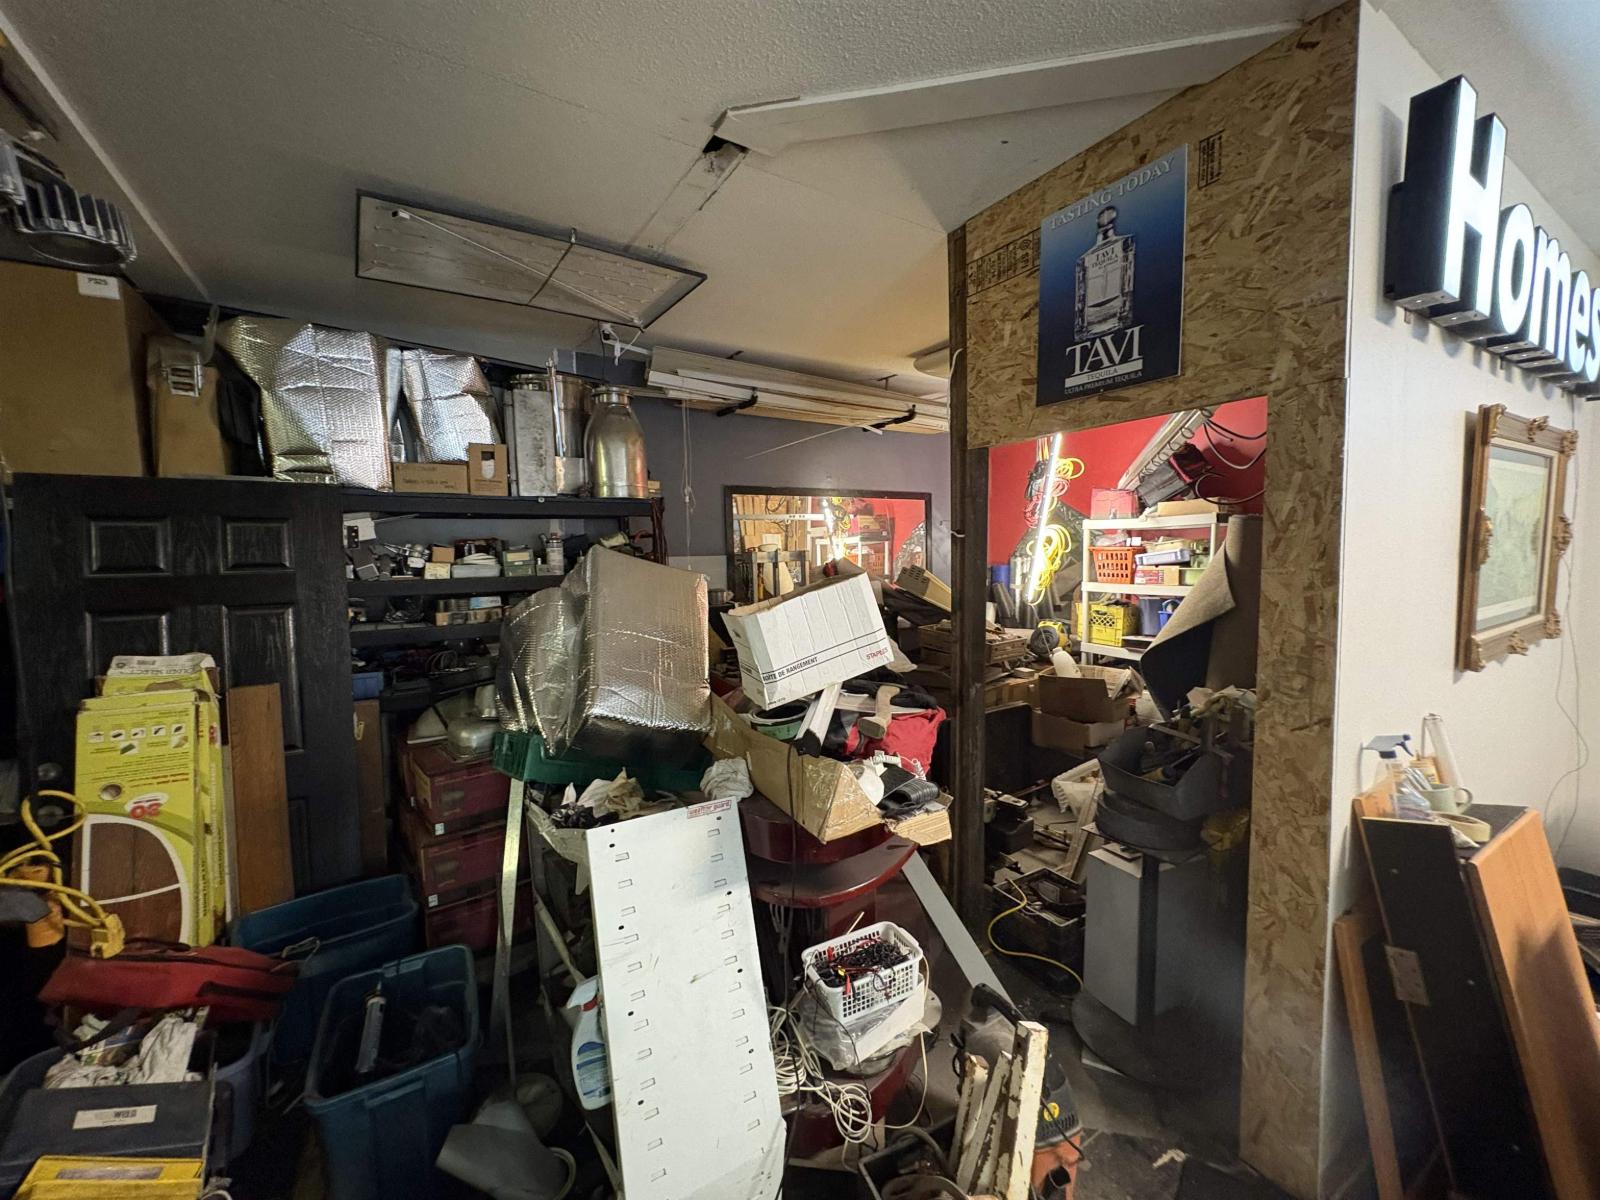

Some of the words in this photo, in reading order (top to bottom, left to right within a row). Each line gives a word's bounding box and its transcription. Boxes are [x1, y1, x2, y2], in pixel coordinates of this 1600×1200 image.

[1050, 189, 1112, 229] TASTING
[1118, 154, 1175, 196] TODAY
[1441, 76, 1600, 383] Homes
[1066, 324, 1144, 376] TAVI
[1086, 367, 1119, 381] TEQUILA
[1114, 371, 1143, 384] TEQUILA
[865, 647, 889, 661] STAPLES
[777, 669, 785, 677] DE
[786, 656, 818, 674] RANGEMENT
